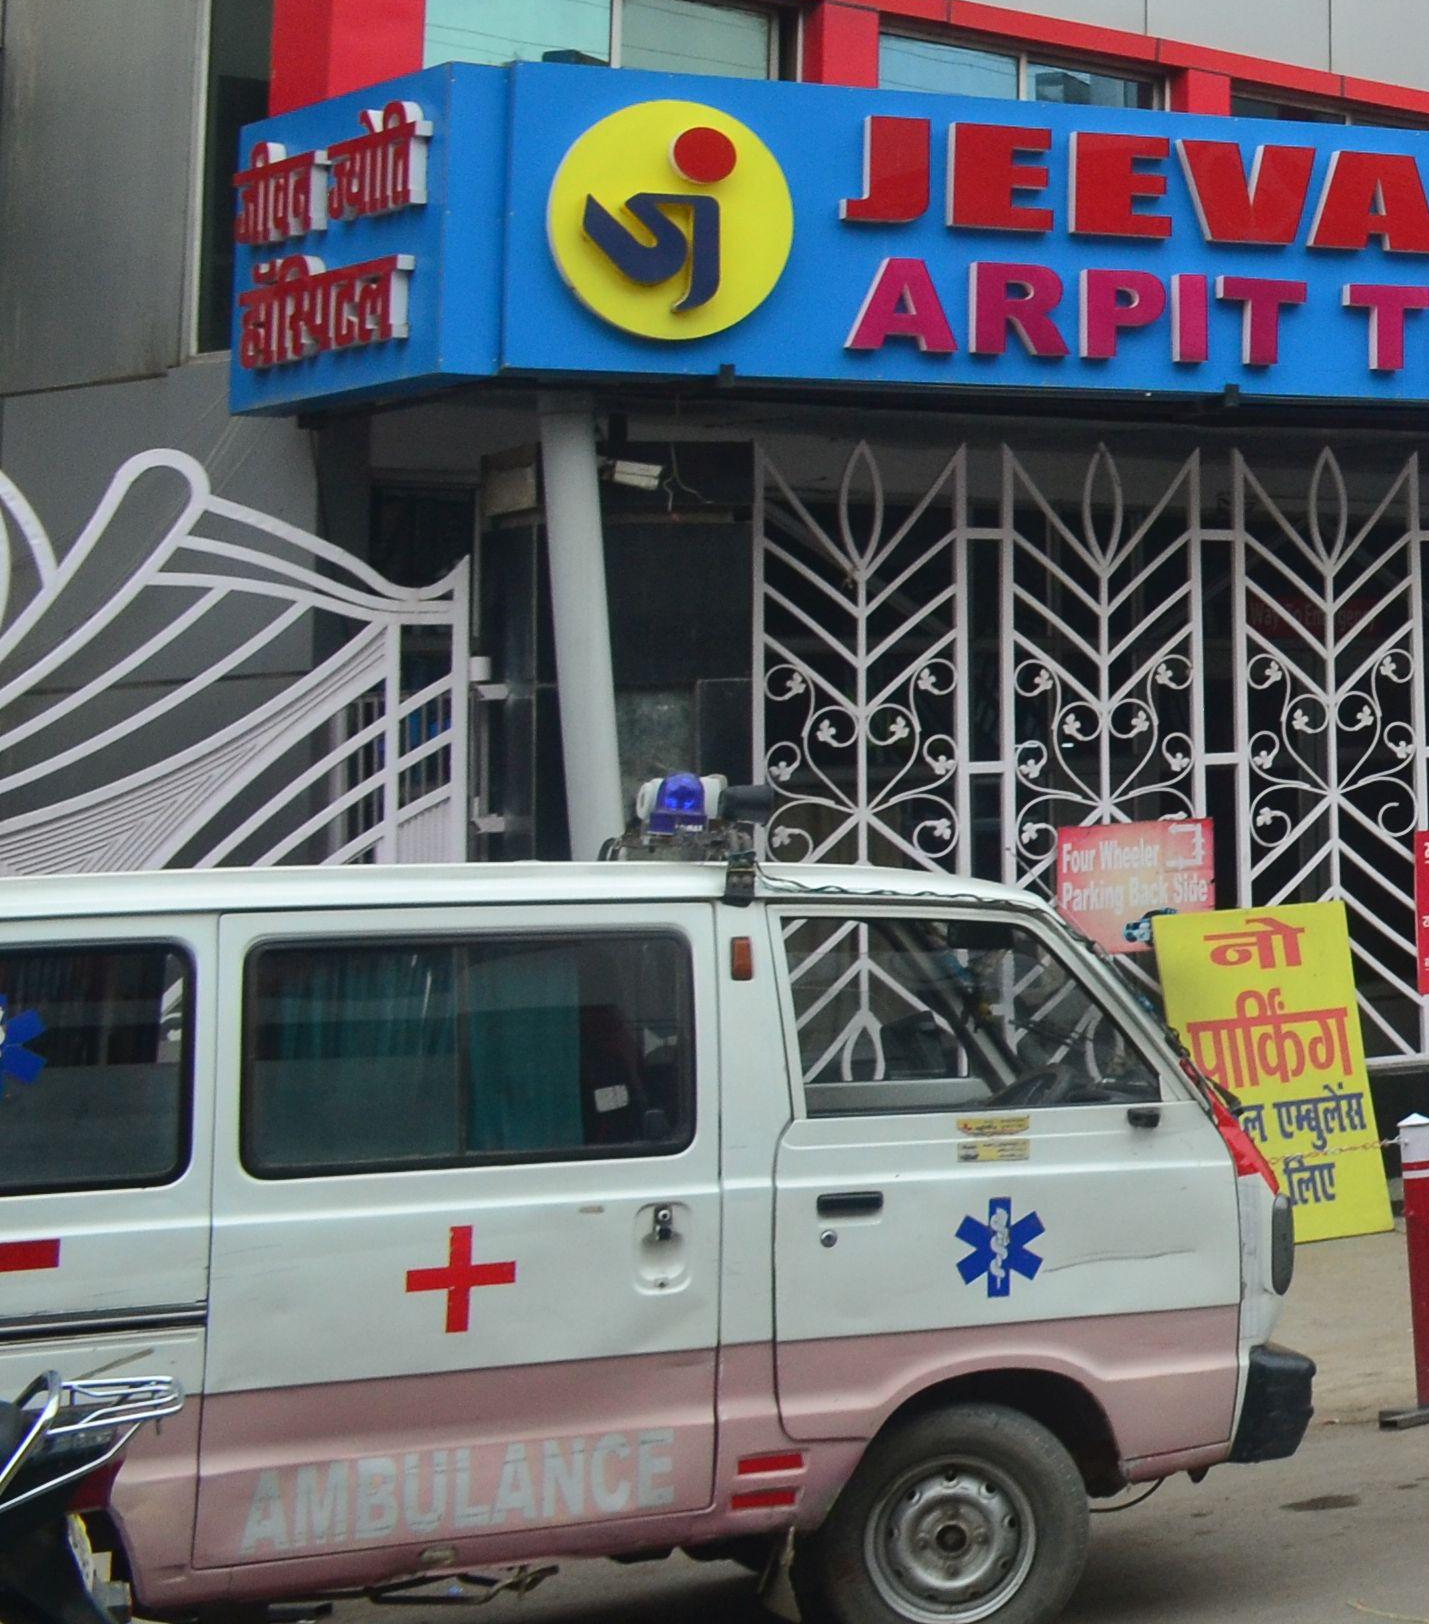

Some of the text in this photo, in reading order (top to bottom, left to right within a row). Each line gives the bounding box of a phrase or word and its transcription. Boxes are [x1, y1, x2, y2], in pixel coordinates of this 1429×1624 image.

[234, 100, 432, 246] जीवन ज्योति
[239, 253, 414, 370] हॉस्पिटल
[844, 257, 1307, 366] ARPIT
[1062, 838, 1160, 874] Four Wheeler
[1062, 872, 1208, 915] Parking Back Side
[1203, 916, 1305, 970] नो
[1186, 987, 1353, 1089] पार्किंग
[1273, 1082, 1368, 1151] एम्बुलेंस
[1283, 1153, 1336, 1207] लिए
[237, 1427, 675, 1557] AMBULANCE
